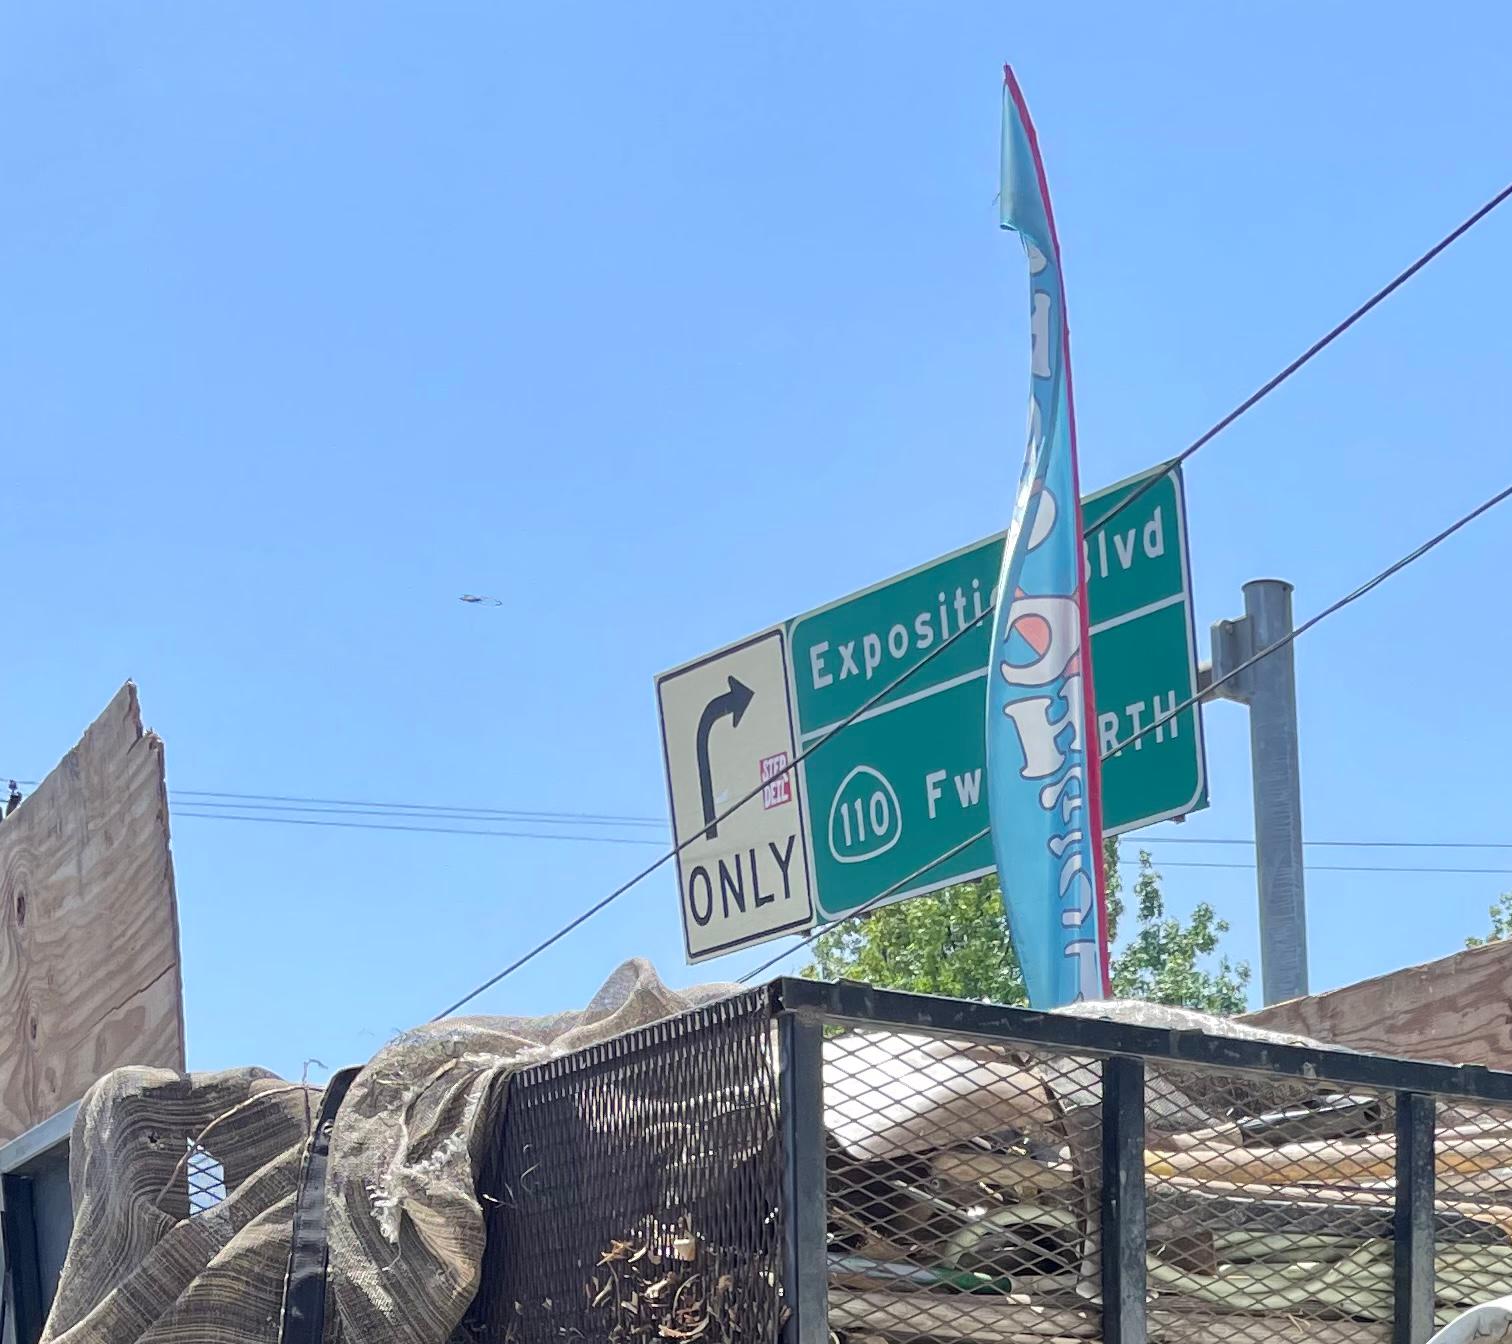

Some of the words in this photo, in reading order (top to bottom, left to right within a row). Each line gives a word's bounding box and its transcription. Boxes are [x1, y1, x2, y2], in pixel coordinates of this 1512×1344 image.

[809, 577, 1000, 690] Expositi
[925, 765, 984, 820] Fw
[1099, 690, 1179, 759] RTH
[840, 794, 893, 847] 110
[687, 834, 797, 927] ONLY
